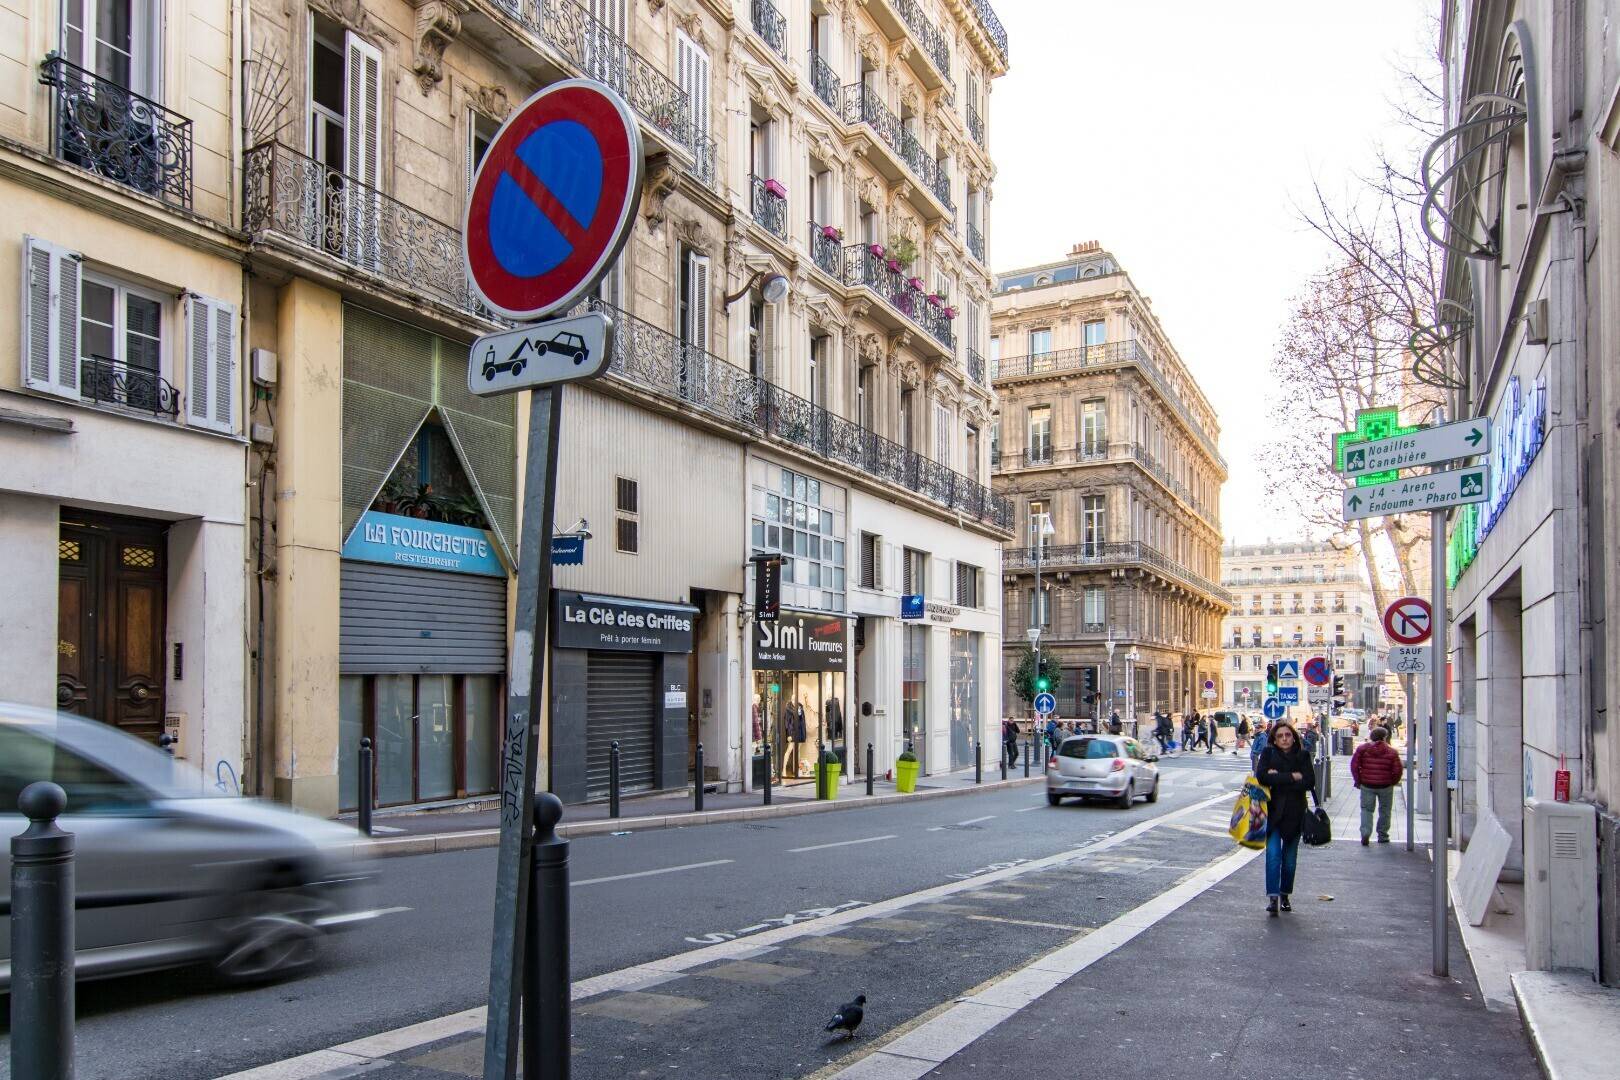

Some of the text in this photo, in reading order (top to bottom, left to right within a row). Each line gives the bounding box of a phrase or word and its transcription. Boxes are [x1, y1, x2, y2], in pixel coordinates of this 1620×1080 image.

[1368, 440, 1416, 456] Noailles
[1368, 450, 1427, 469] Canebière
[1401, 481, 1436, 494] Arenc
[1368, 498, 1414, 513] Endoume
[1426, 491, 1457, 504] Pharo
[364, 522, 489, 558] LA FOURCHETTE
[565, 605, 587, 623] La
[617, 610, 645, 628] des
[647, 613, 692, 632] Griffes
[759, 618, 804, 650] Simi
[809, 637, 844, 654] Fourrures
